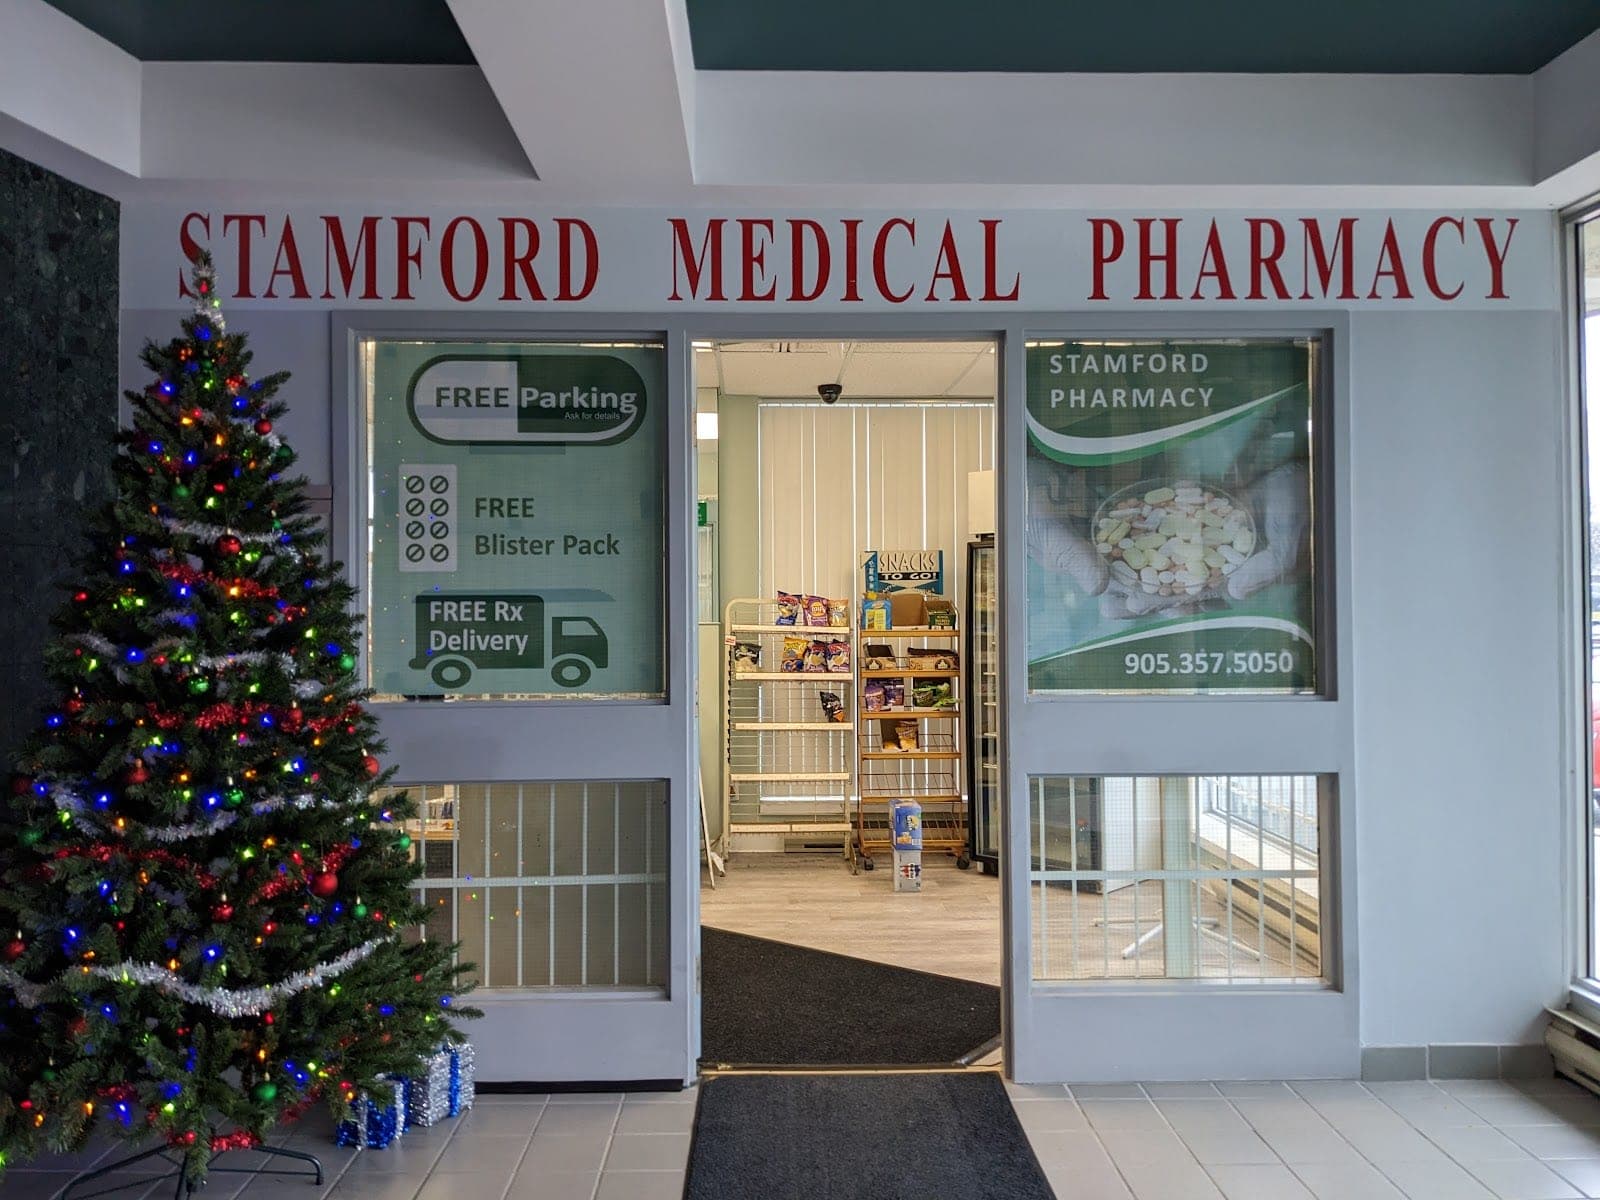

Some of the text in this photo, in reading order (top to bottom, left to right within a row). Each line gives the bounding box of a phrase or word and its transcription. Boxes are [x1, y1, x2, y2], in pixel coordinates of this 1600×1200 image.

[179, 212, 1520, 303] STAMFORD MEDICAL PHARMACY
[1049, 353, 1209, 375] STAMFORD
[435, 386, 639, 414] FREE Parking
[1050, 387, 1214, 409] PHARMACY
[565, 411, 621, 420] Ask for details
[474, 497, 535, 518] FREE
[474, 534, 620, 556] Blister Pack
[879, 551, 936, 572] SNACKS
[910, 572, 937, 580] GO!
[429, 600, 524, 622] FREE Rx
[429, 629, 529, 656] Delivery
[1124, 652, 1294, 676] 905.357.5050
